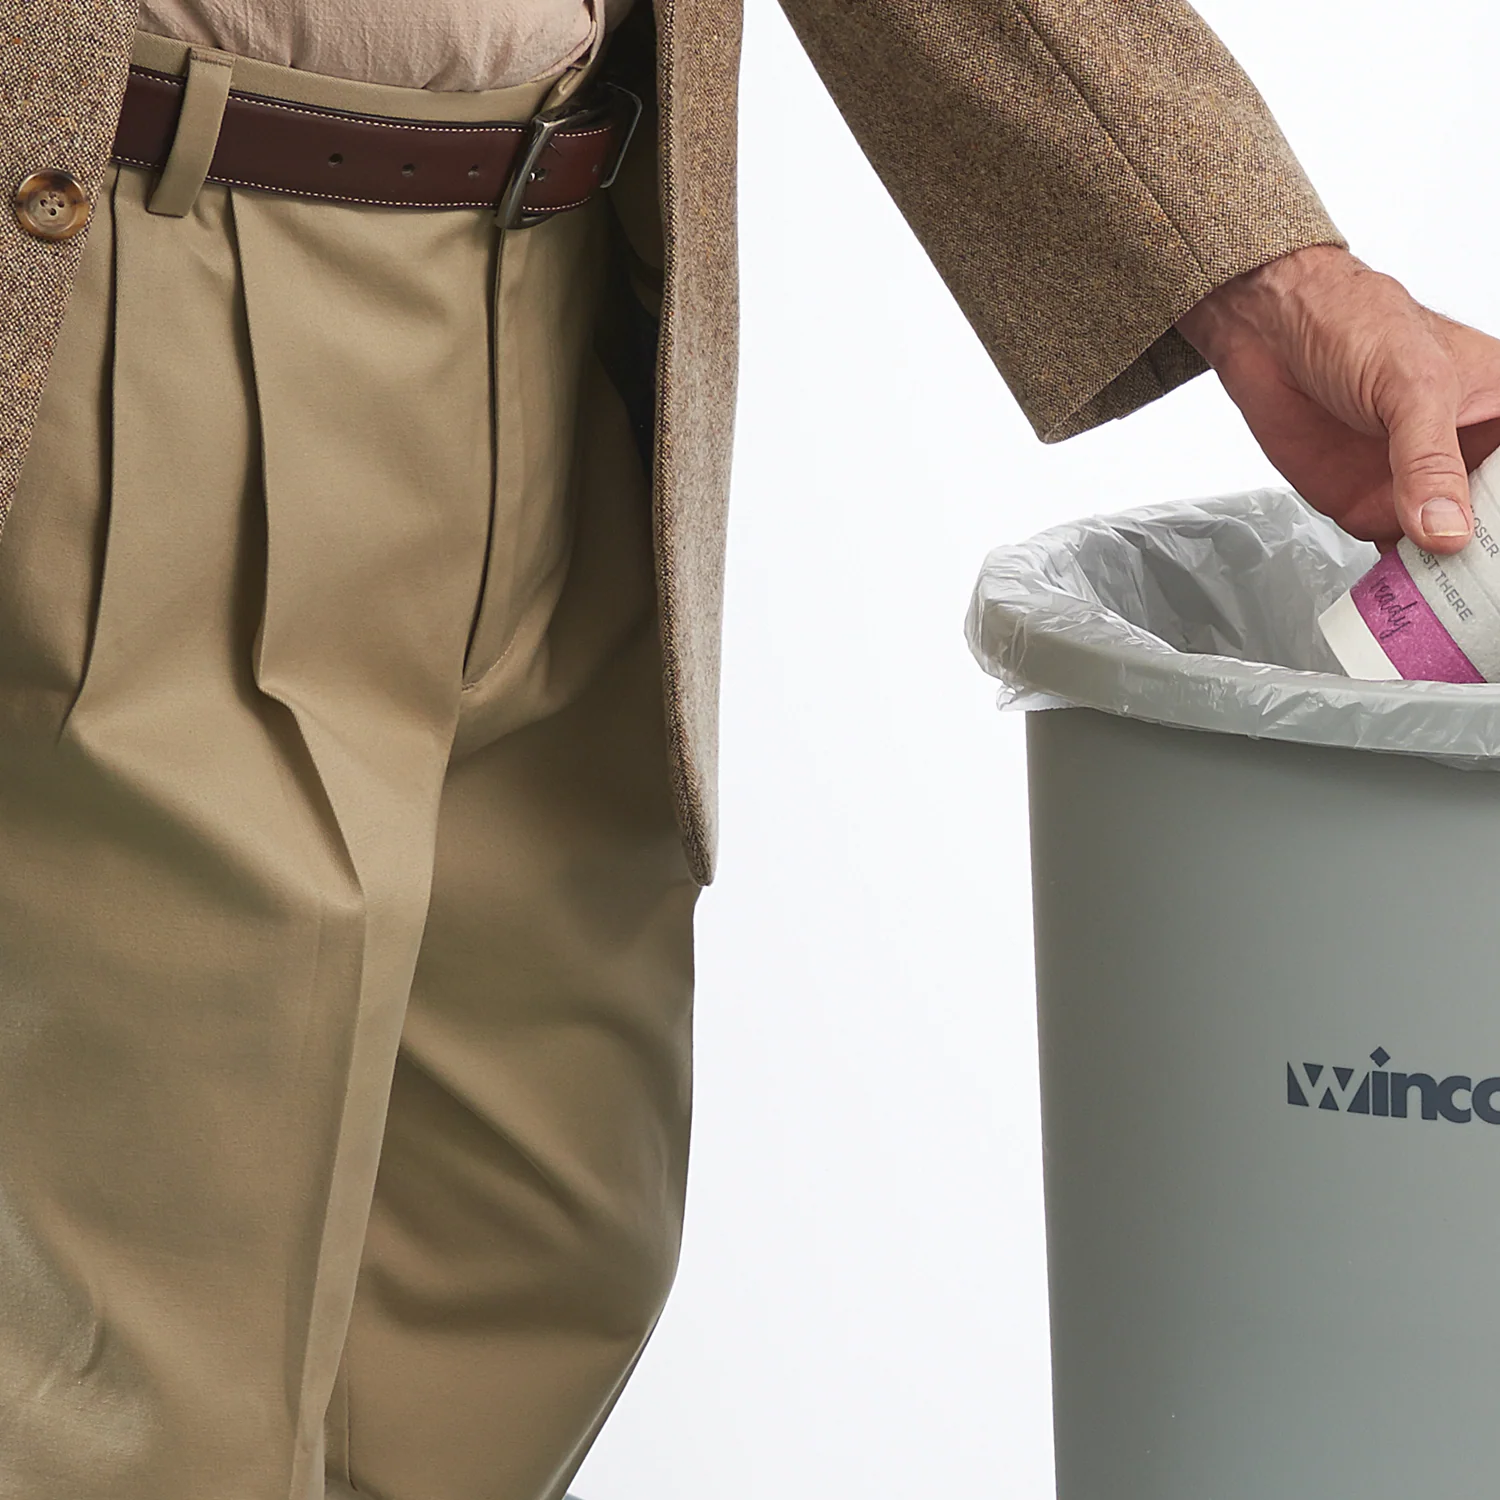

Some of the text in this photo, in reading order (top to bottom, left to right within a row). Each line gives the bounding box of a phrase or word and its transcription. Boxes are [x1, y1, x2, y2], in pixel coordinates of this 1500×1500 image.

[1470, 504, 1500, 558] OSER
[1370, 576, 1418, 640] ready
[1435, 570, 1473, 621] THERE
